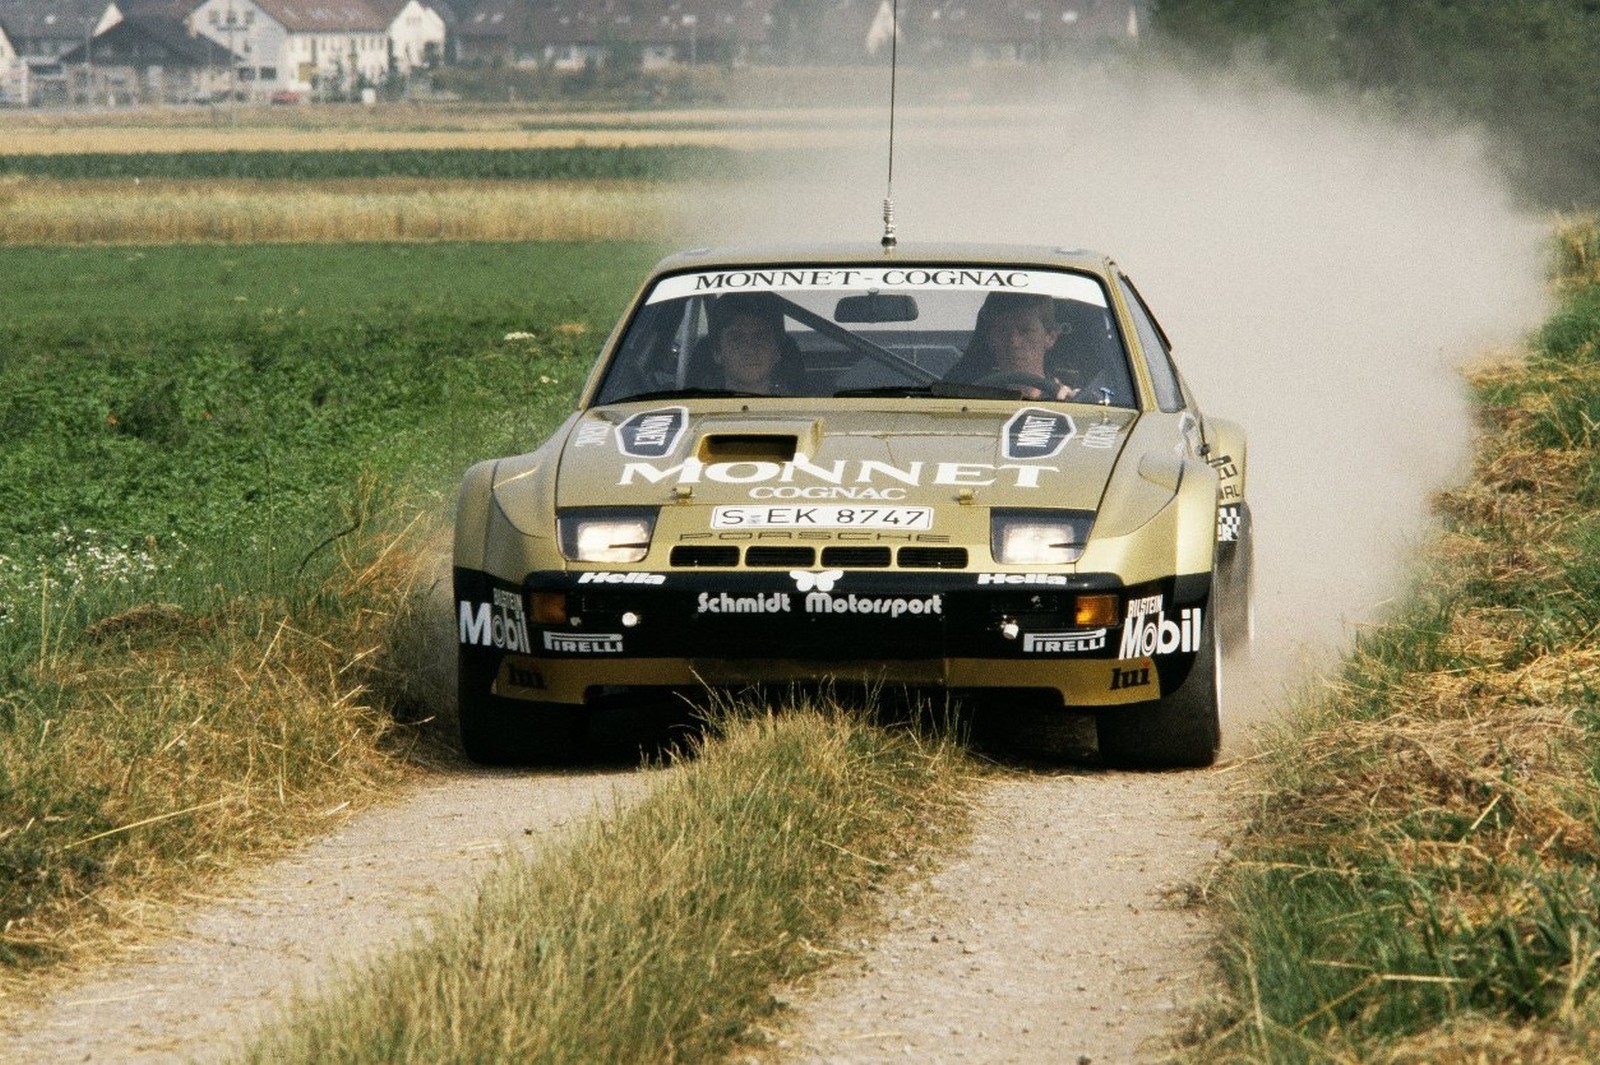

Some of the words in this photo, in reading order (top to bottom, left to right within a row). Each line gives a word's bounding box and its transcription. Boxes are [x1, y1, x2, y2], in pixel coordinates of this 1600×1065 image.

[616, 454, 1060, 488] MONNET
[748, 486, 907, 500] COGNAC
[836, 508, 926, 526] 8747
[679, 531, 951, 543] PORSCHE
[577, 572, 667, 585] Hella
[977, 573, 1068, 586] Hella
[697, 592, 792, 614] Schmidt
[805, 592, 943, 619] Motorsport
[459, 599, 532, 655] Mobil
[1117, 607, 1203, 661] Mobil
[542, 630, 624, 653] PIRELLI
[1022, 627, 1108, 653] PIRELLI
[1109, 659, 1151, 690] lui
